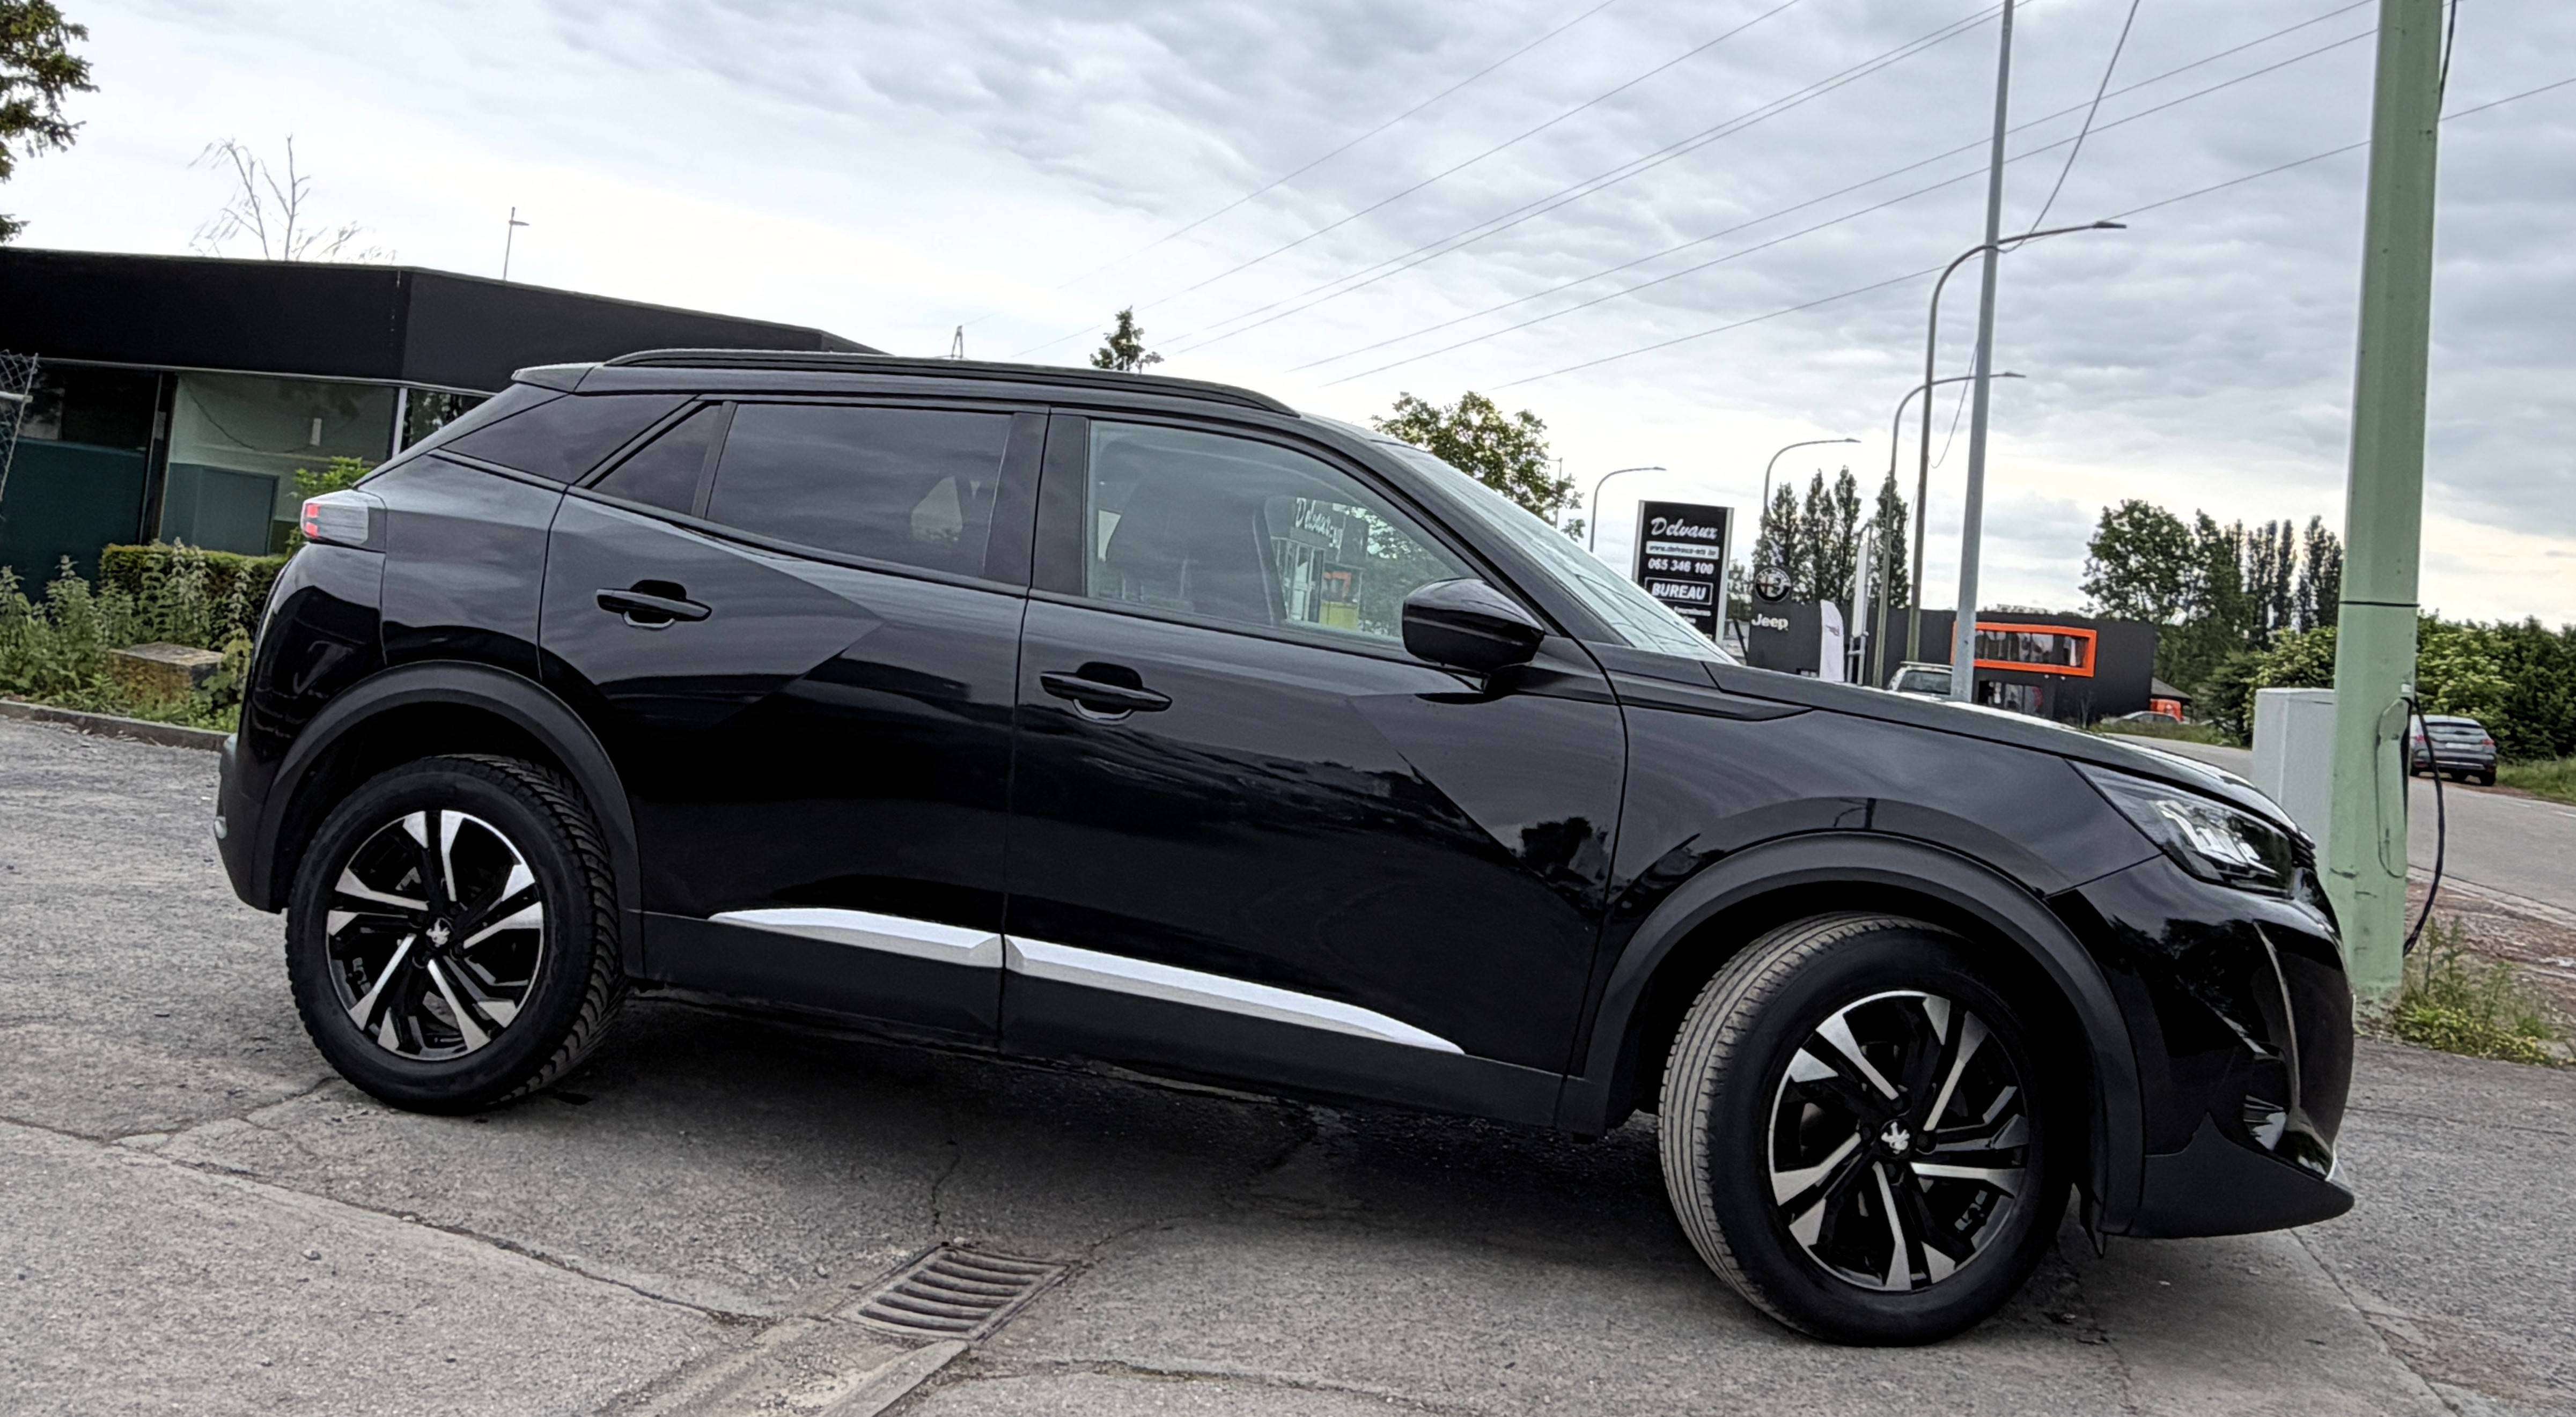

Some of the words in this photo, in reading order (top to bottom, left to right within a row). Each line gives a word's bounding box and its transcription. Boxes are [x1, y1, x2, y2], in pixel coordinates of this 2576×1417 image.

[1651, 516, 1718, 540] Delvaux
[1647, 557, 1668, 571] 065
[1651, 582, 1707, 600] BUREAU
[1751, 614, 1789, 630] Jeep
